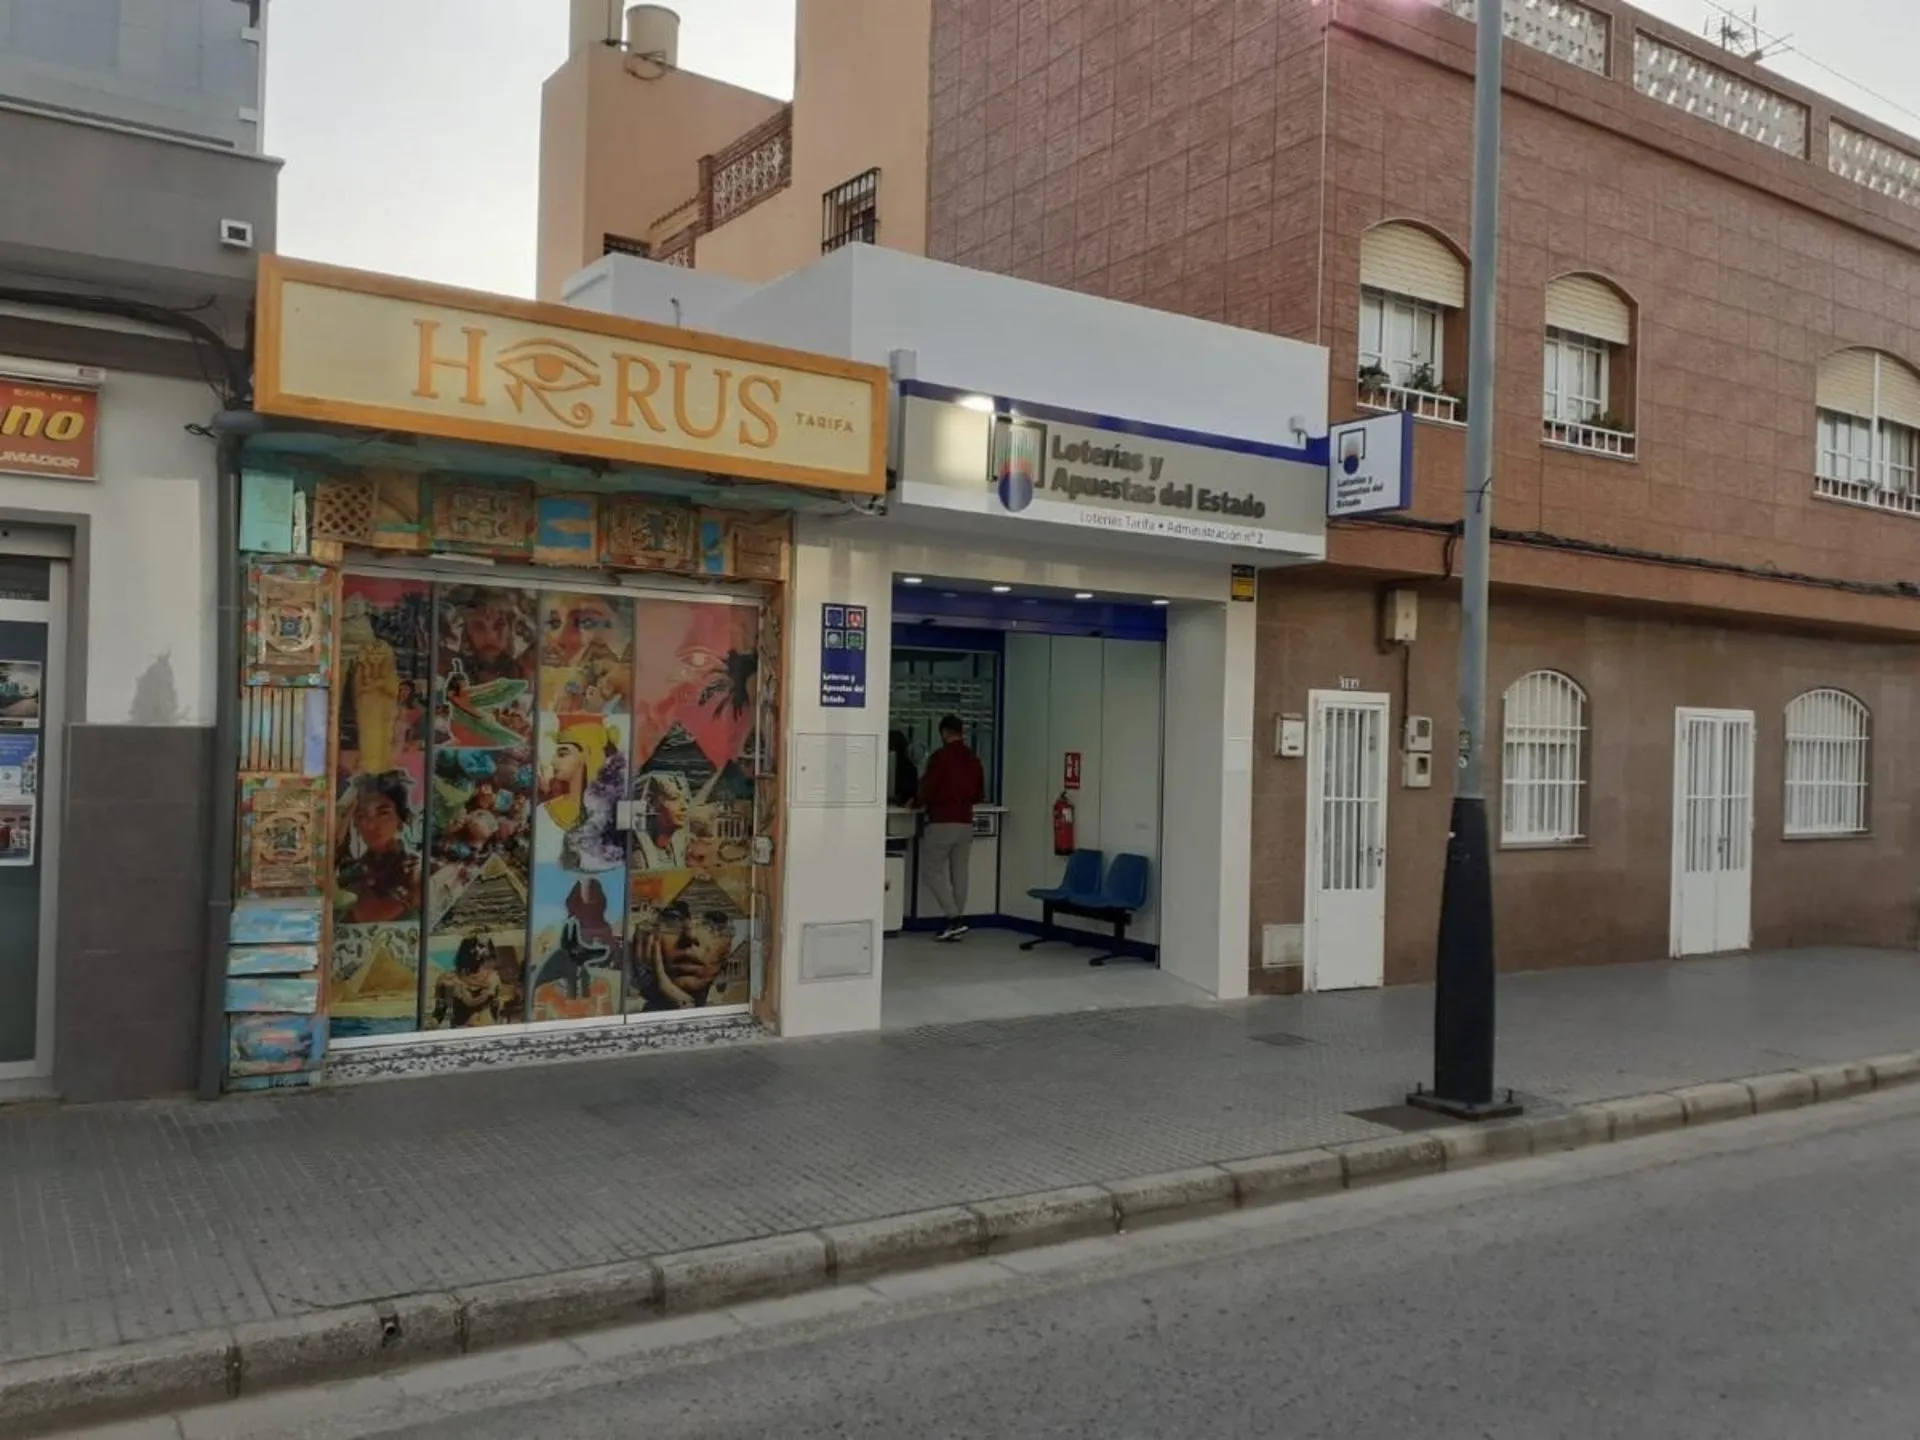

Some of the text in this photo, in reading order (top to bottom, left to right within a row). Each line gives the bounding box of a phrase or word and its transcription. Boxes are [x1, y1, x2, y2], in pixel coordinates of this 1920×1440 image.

[795, 411, 855, 433] TARIFA
[1052, 435, 1165, 481] Loterías y
[1051, 466, 1266, 519] Apuestas del Estado
[1125, 515, 1154, 531] Tarifa
